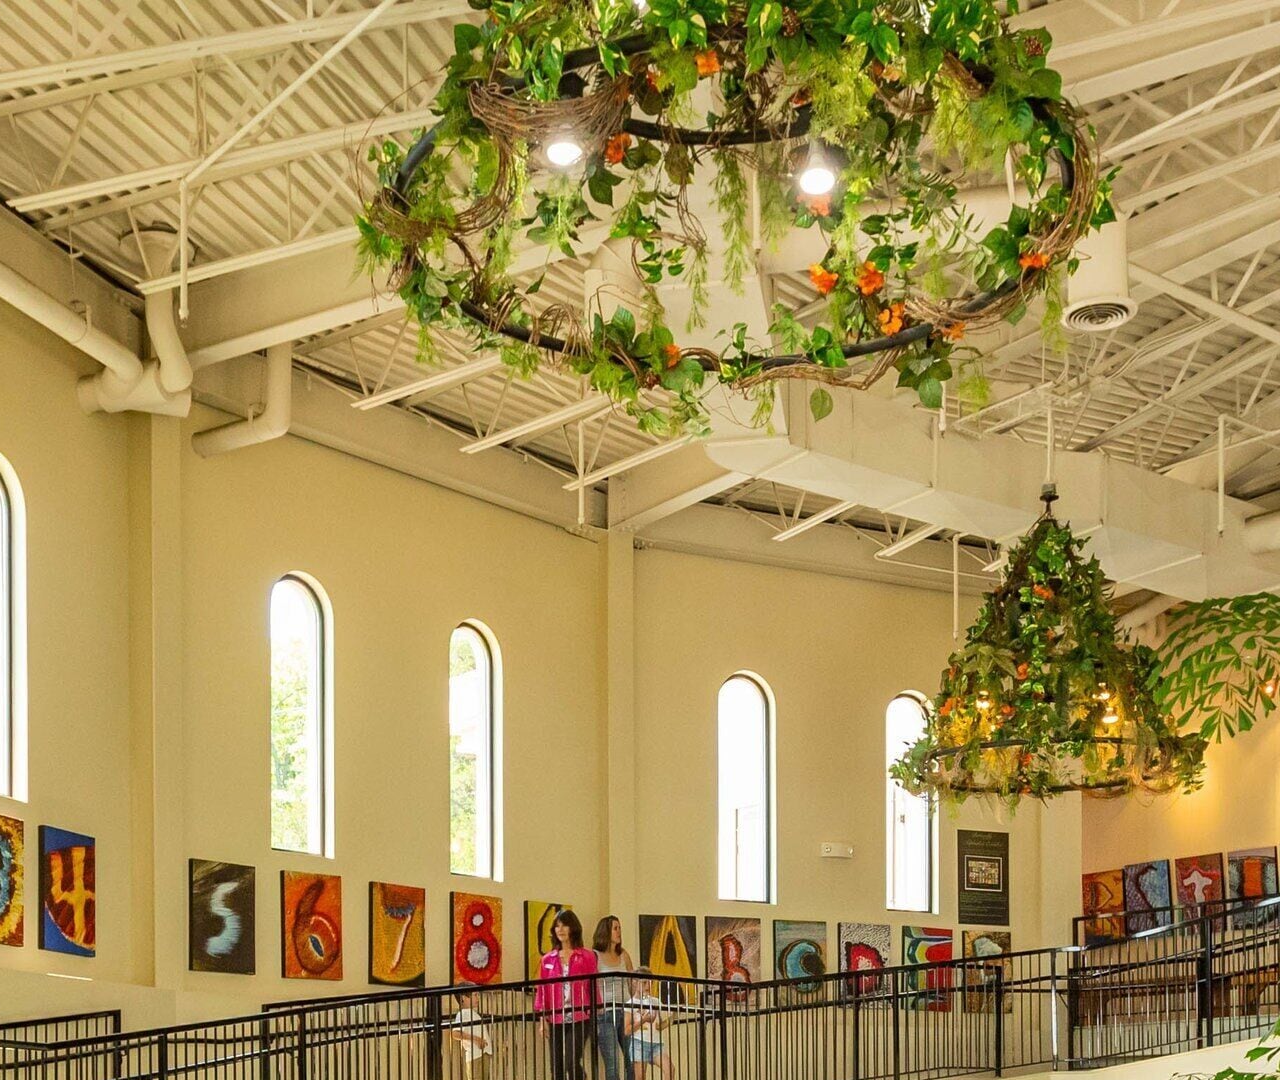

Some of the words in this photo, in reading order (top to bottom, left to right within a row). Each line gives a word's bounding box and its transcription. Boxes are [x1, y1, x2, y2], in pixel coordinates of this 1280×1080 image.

[49, 845, 96, 948] 4
[292, 877, 341, 977] 6
[457, 900, 501, 984] 8
